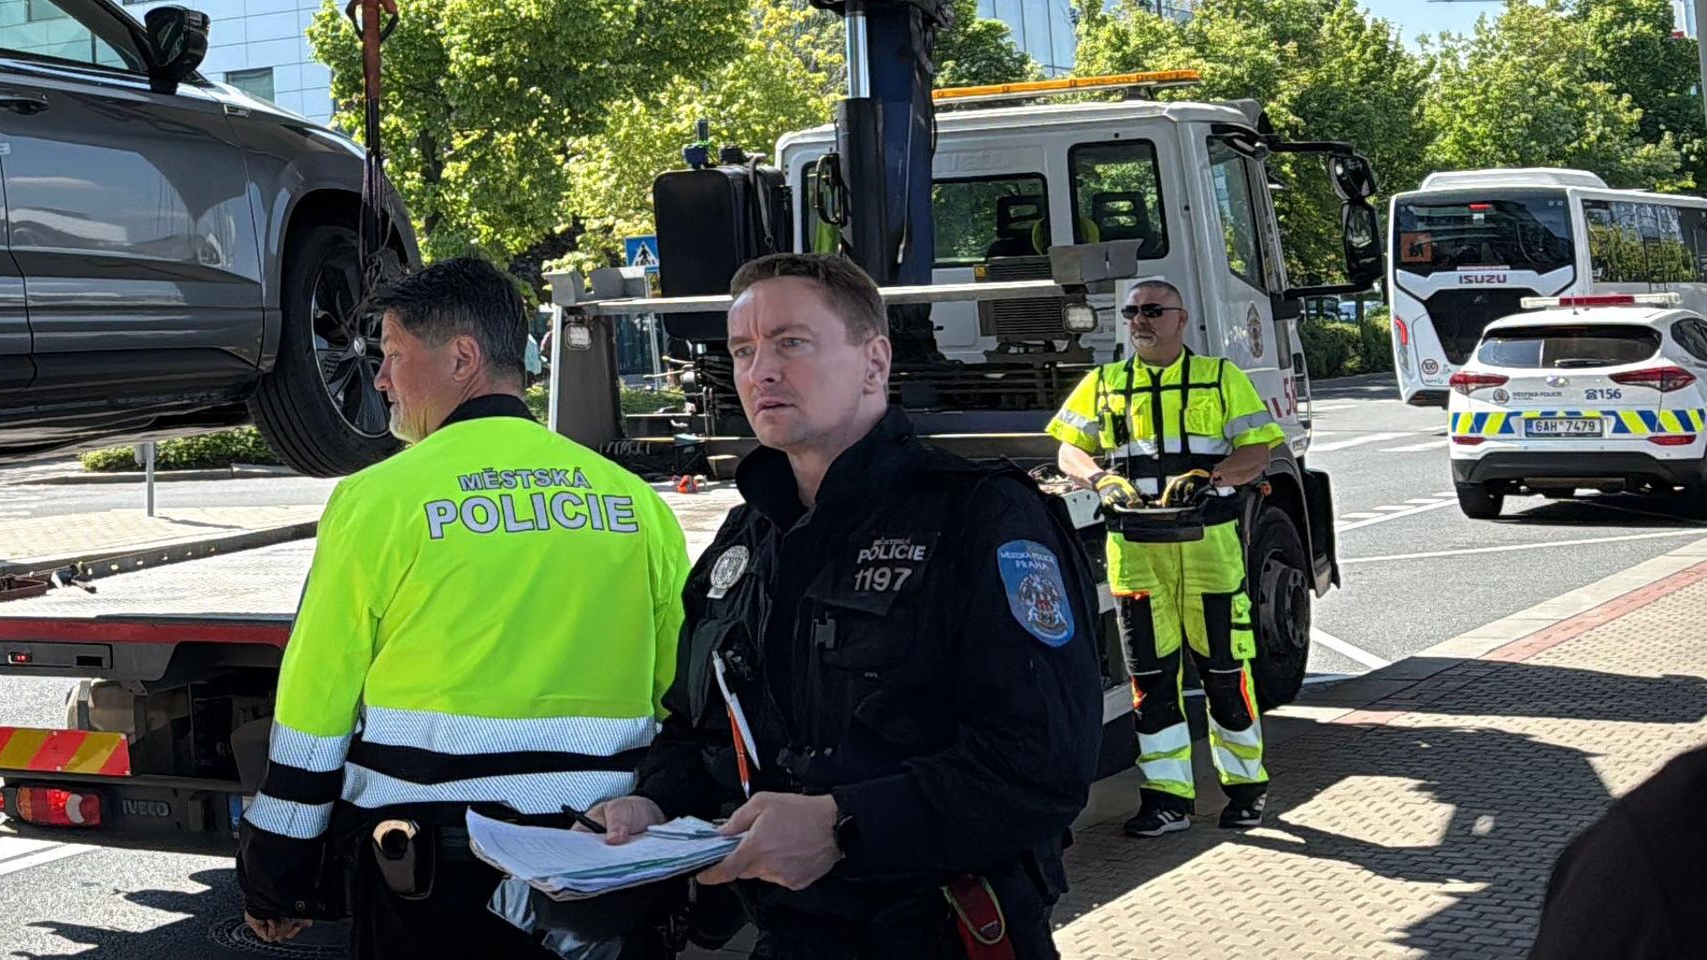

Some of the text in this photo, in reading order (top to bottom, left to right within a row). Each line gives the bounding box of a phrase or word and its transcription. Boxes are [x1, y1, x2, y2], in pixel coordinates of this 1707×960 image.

[1459, 273, 1507, 285] ISUZU
[1597, 388, 1622, 400] 156
[1535, 421, 1595, 432] 6AH 7479
[457, 467, 593, 492] MĚSTSKÁ
[424, 491, 639, 540] POLICIE
[856, 544, 926, 564] POLICIE
[854, 566, 912, 591] 1197
[123, 799, 171, 817] IVECO
